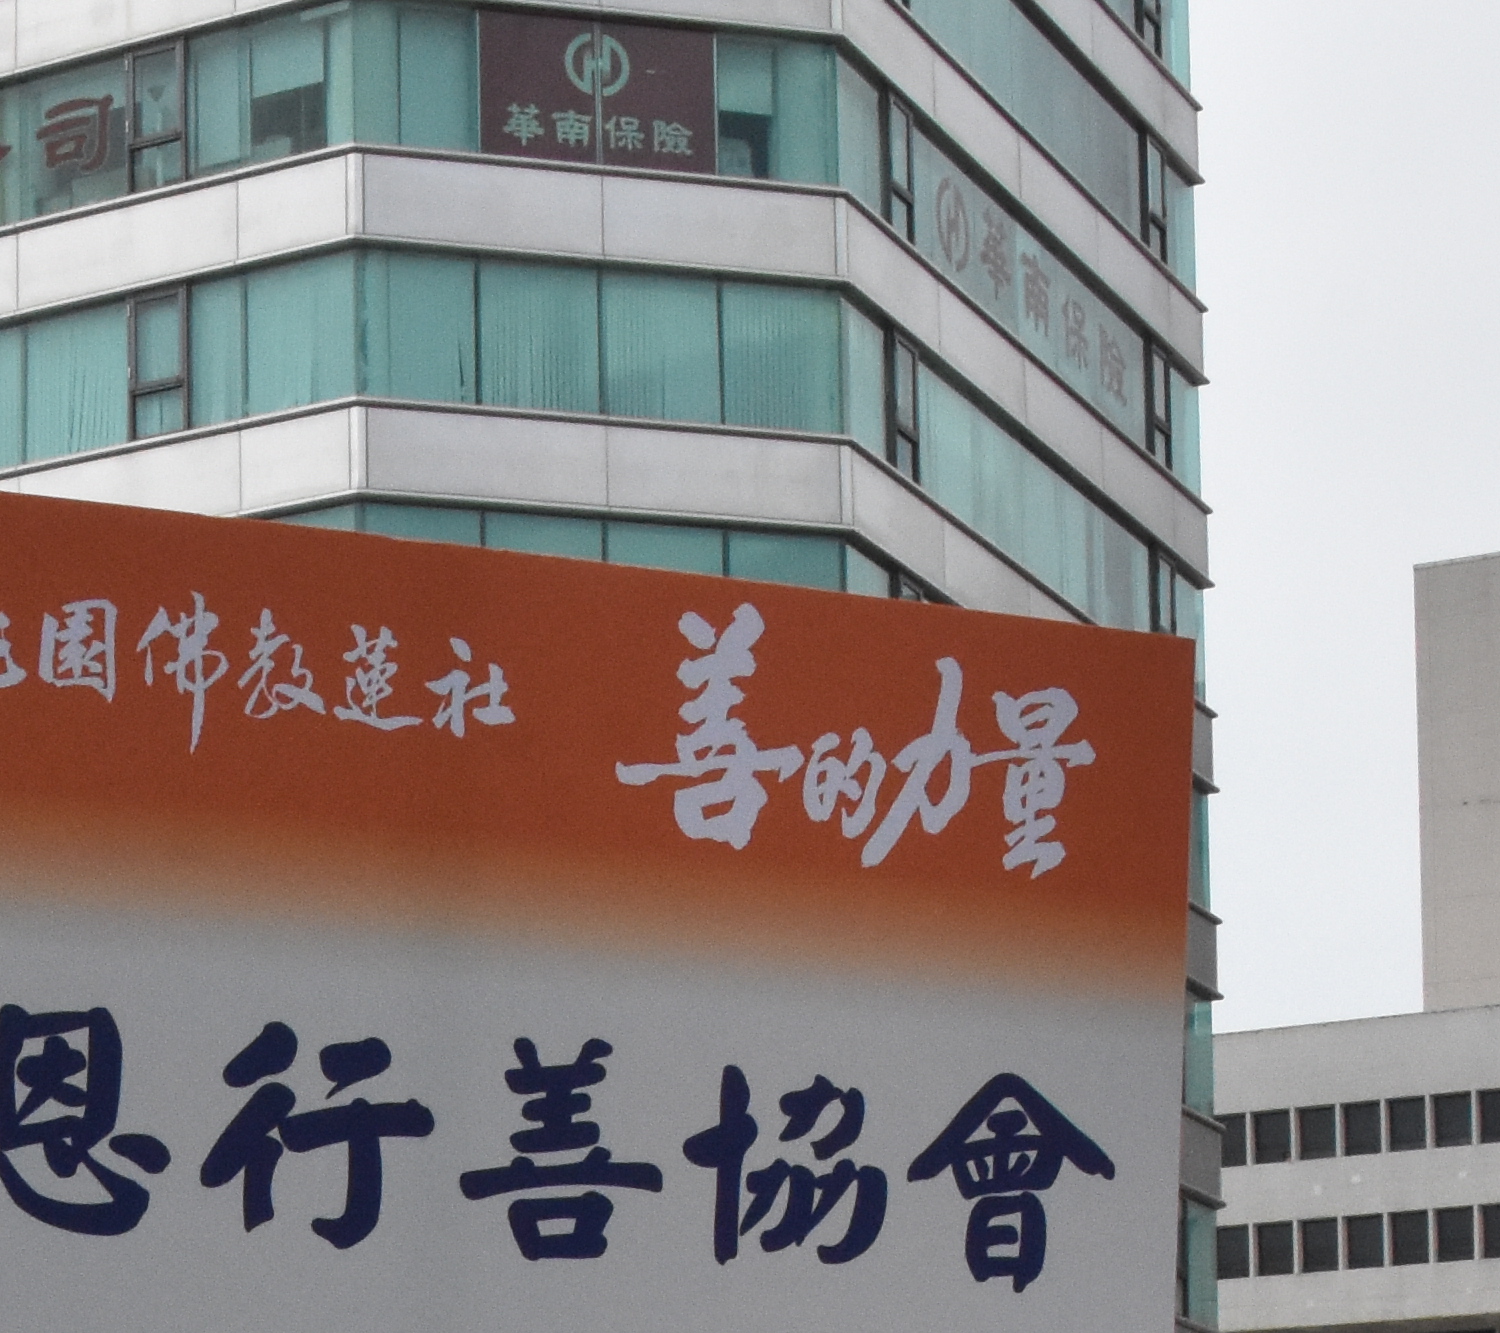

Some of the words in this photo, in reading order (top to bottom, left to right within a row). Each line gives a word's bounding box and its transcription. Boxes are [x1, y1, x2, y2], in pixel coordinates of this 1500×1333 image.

[503, 103, 693, 157] 華南保險
[979, 205, 1128, 408] 華南保險
[615, 603, 1098, 880] 善的力量
